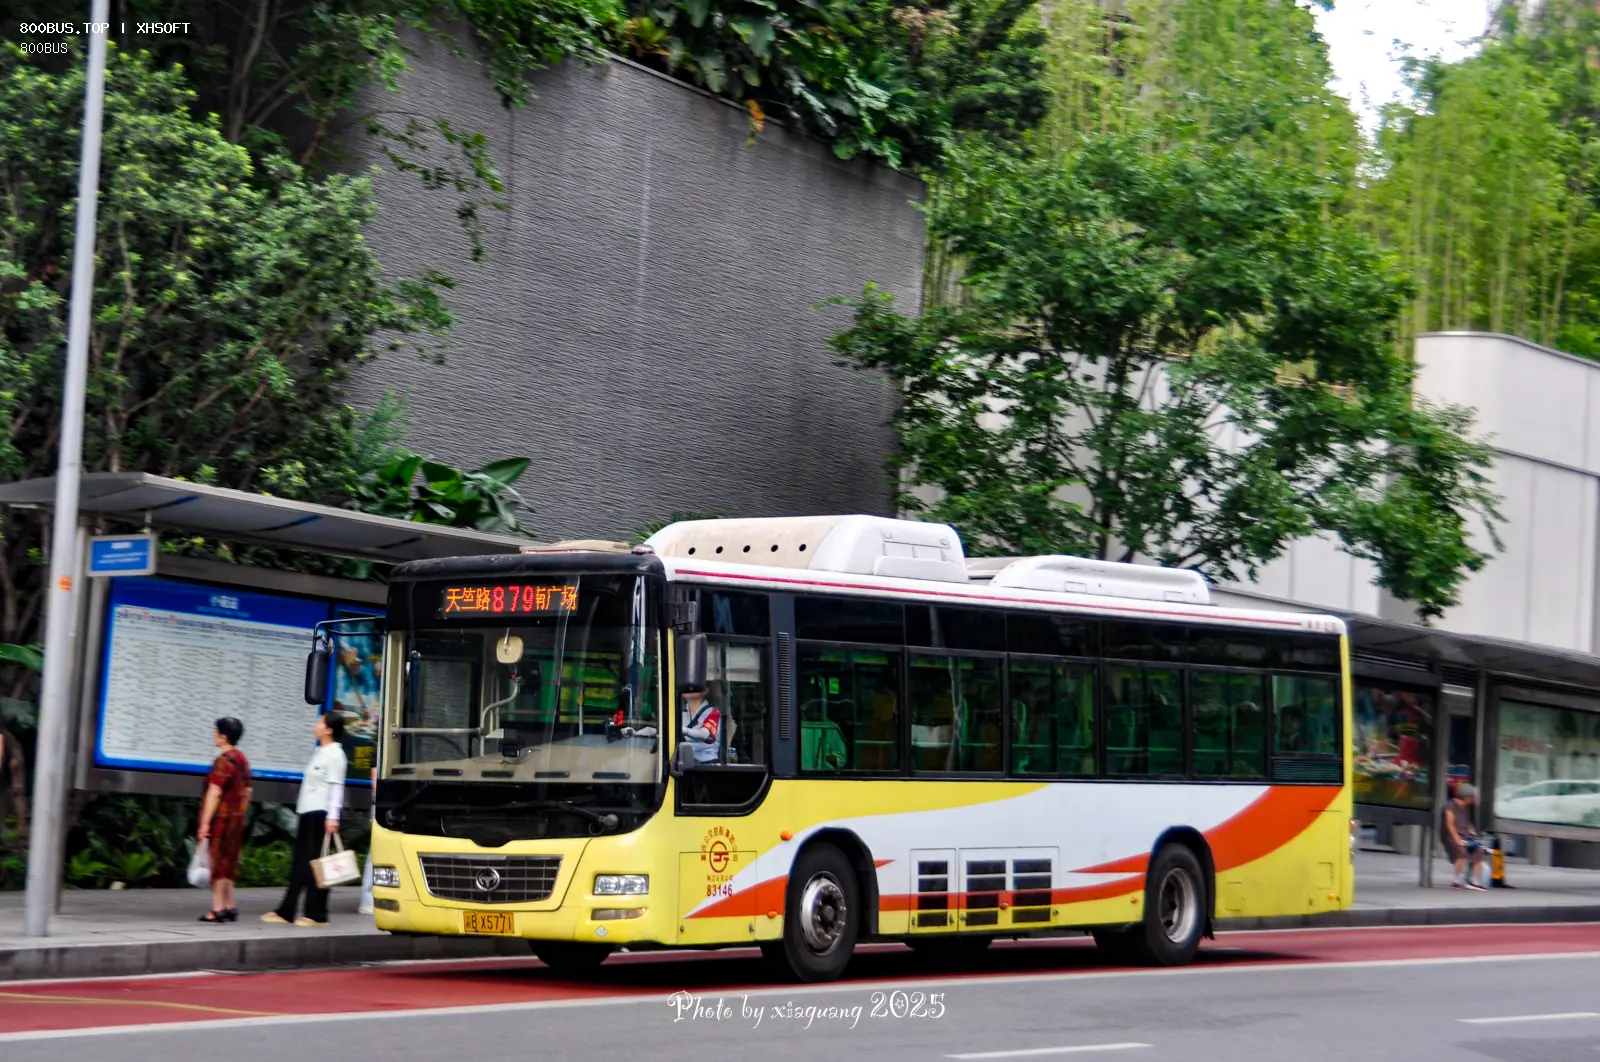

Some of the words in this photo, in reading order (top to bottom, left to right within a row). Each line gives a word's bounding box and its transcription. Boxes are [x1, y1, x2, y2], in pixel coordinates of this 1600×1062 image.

[446, 587, 490, 612] 天竺路
[492, 585, 535, 613] 879
[706, 884, 733, 897] 83146
